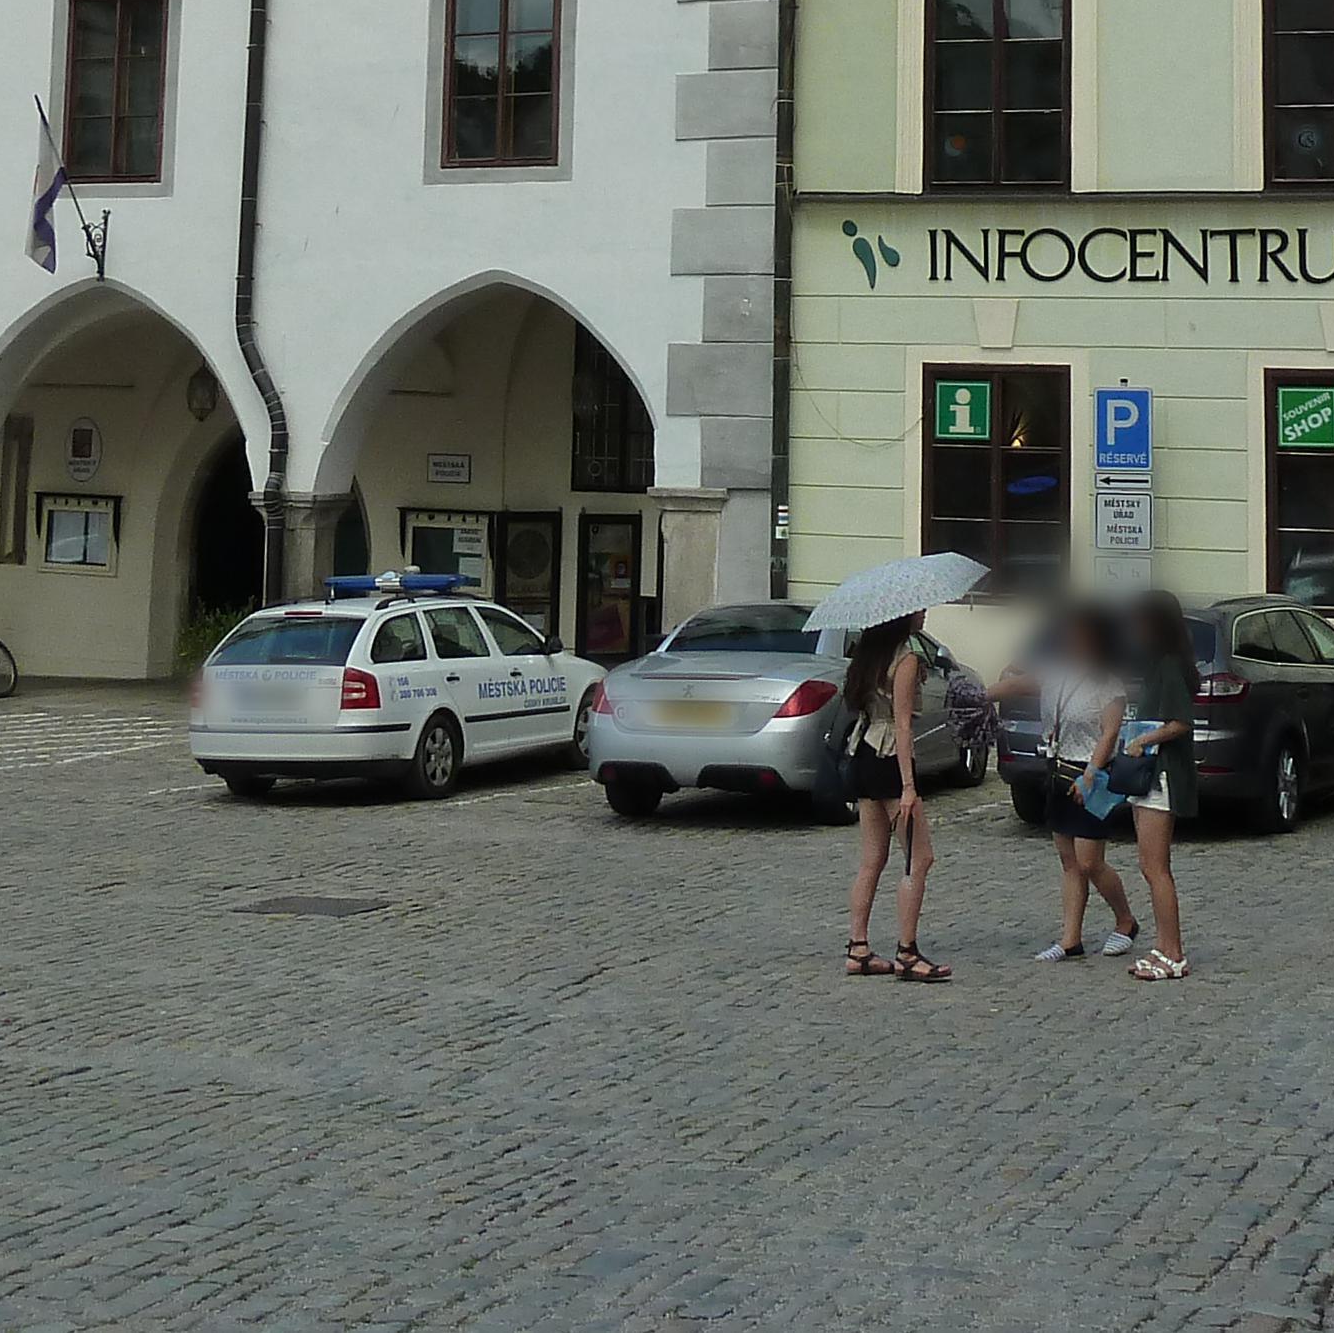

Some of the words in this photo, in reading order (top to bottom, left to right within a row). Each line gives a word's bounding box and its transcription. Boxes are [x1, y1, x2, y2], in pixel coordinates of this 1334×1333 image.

[1283, 392, 1331, 421] SOUVENIR
[1106, 398, 1139, 446] P
[1284, 407, 1332, 441] SHOP
[1110, 536, 1139, 545] POLICIE
[274, 670, 317, 681] POLICIE
[529, 676, 567, 695] POLICIE
